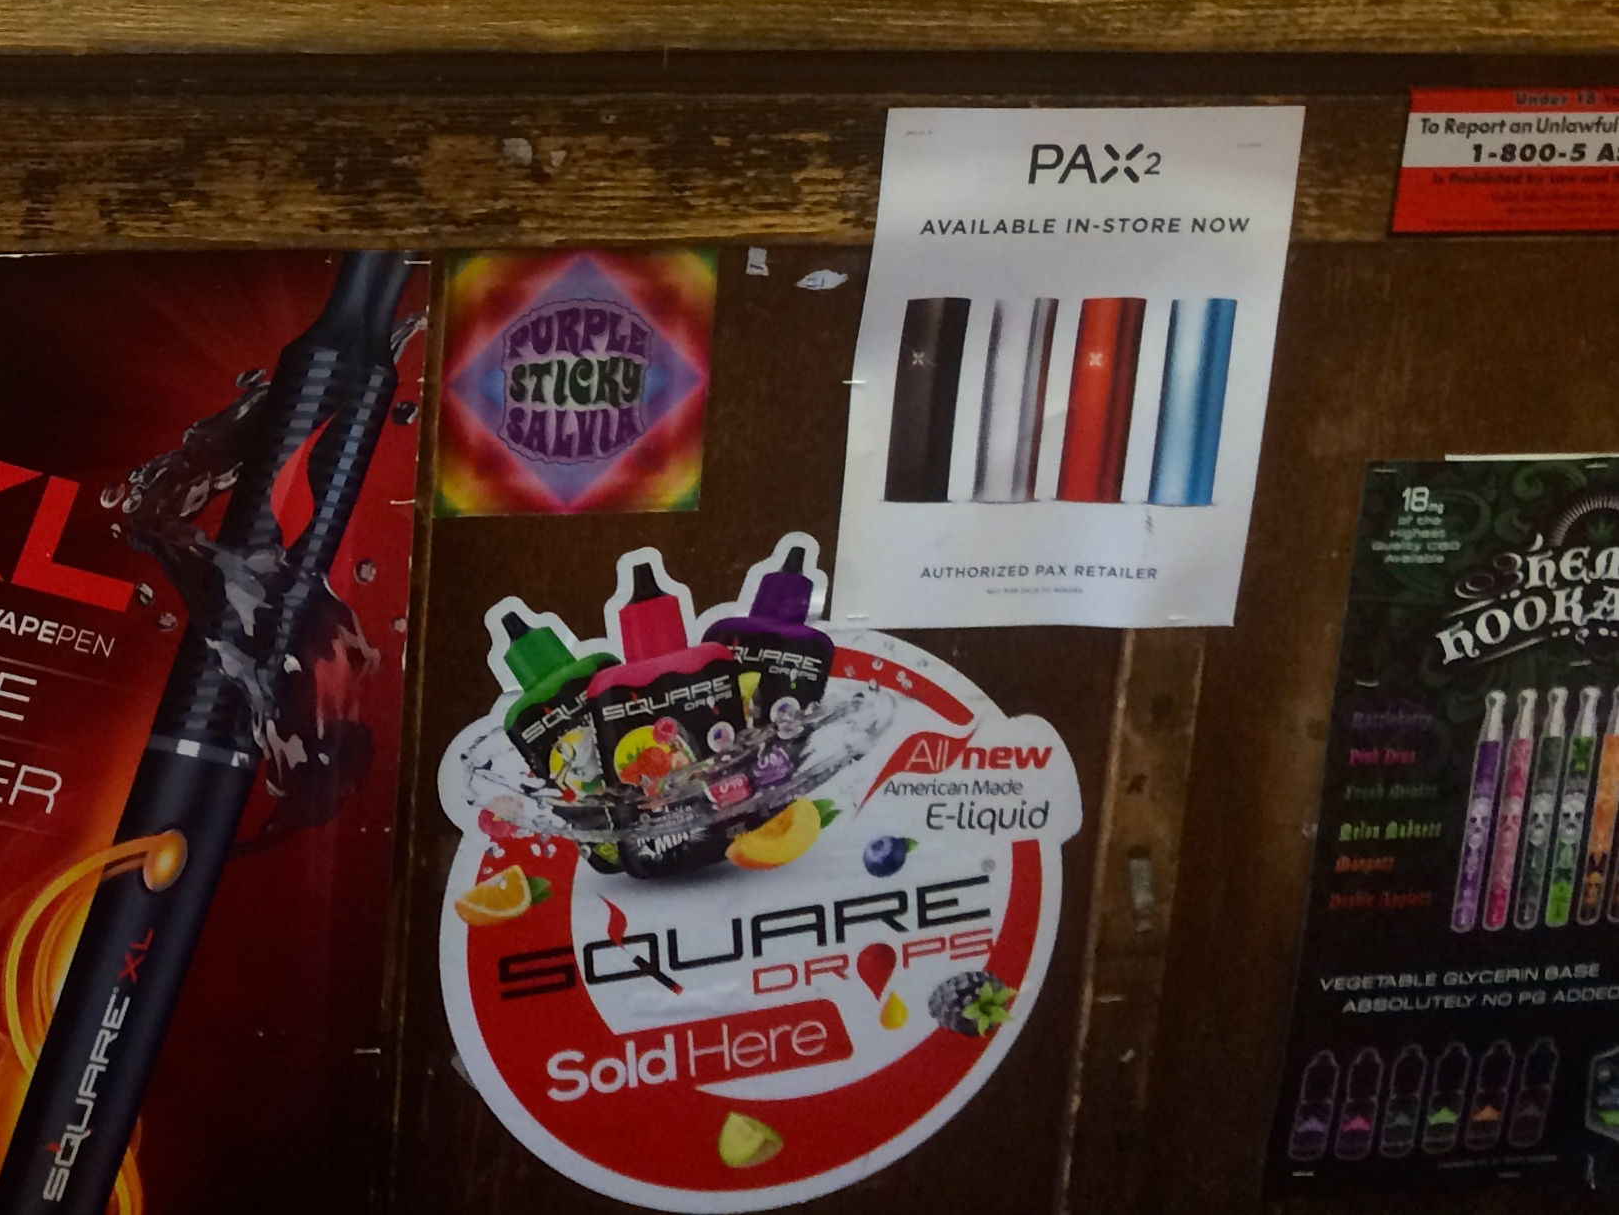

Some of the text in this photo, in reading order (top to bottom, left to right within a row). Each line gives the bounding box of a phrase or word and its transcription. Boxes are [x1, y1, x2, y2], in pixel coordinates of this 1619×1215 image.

[1421, 116, 1618, 138] To Report an Unlawful
[1028, 143, 1144, 185] PAX
[1473, 143, 1586, 162] 1-800-5
[920, 217, 1251, 236] AVAILABLE IN-STORE NOW
[508, 307, 649, 358] PURPLE
[510, 357, 642, 408] STICKY
[507, 407, 638, 456] SALVIA
[1402, 487, 1429, 512] 18
[921, 565, 1157, 580] AUTHORIZED PAX RETAILER
[602, 675, 731, 721] SQUARE
[905, 740, 1052, 773] All new
[884, 778, 1023, 798] American Made
[925, 801, 1050, 833] E-liquid
[499, 874, 992, 1000] SQUARE
[1321, 964, 1599, 991] VEGETABLE GLYCERIN BASE
[1343, 987, 1619, 1013] ABSOLUTELY NO PG ADDED
[42, 929, 155, 1202] SQUARE XL
[546, 1018, 828, 1102] Sold Here
